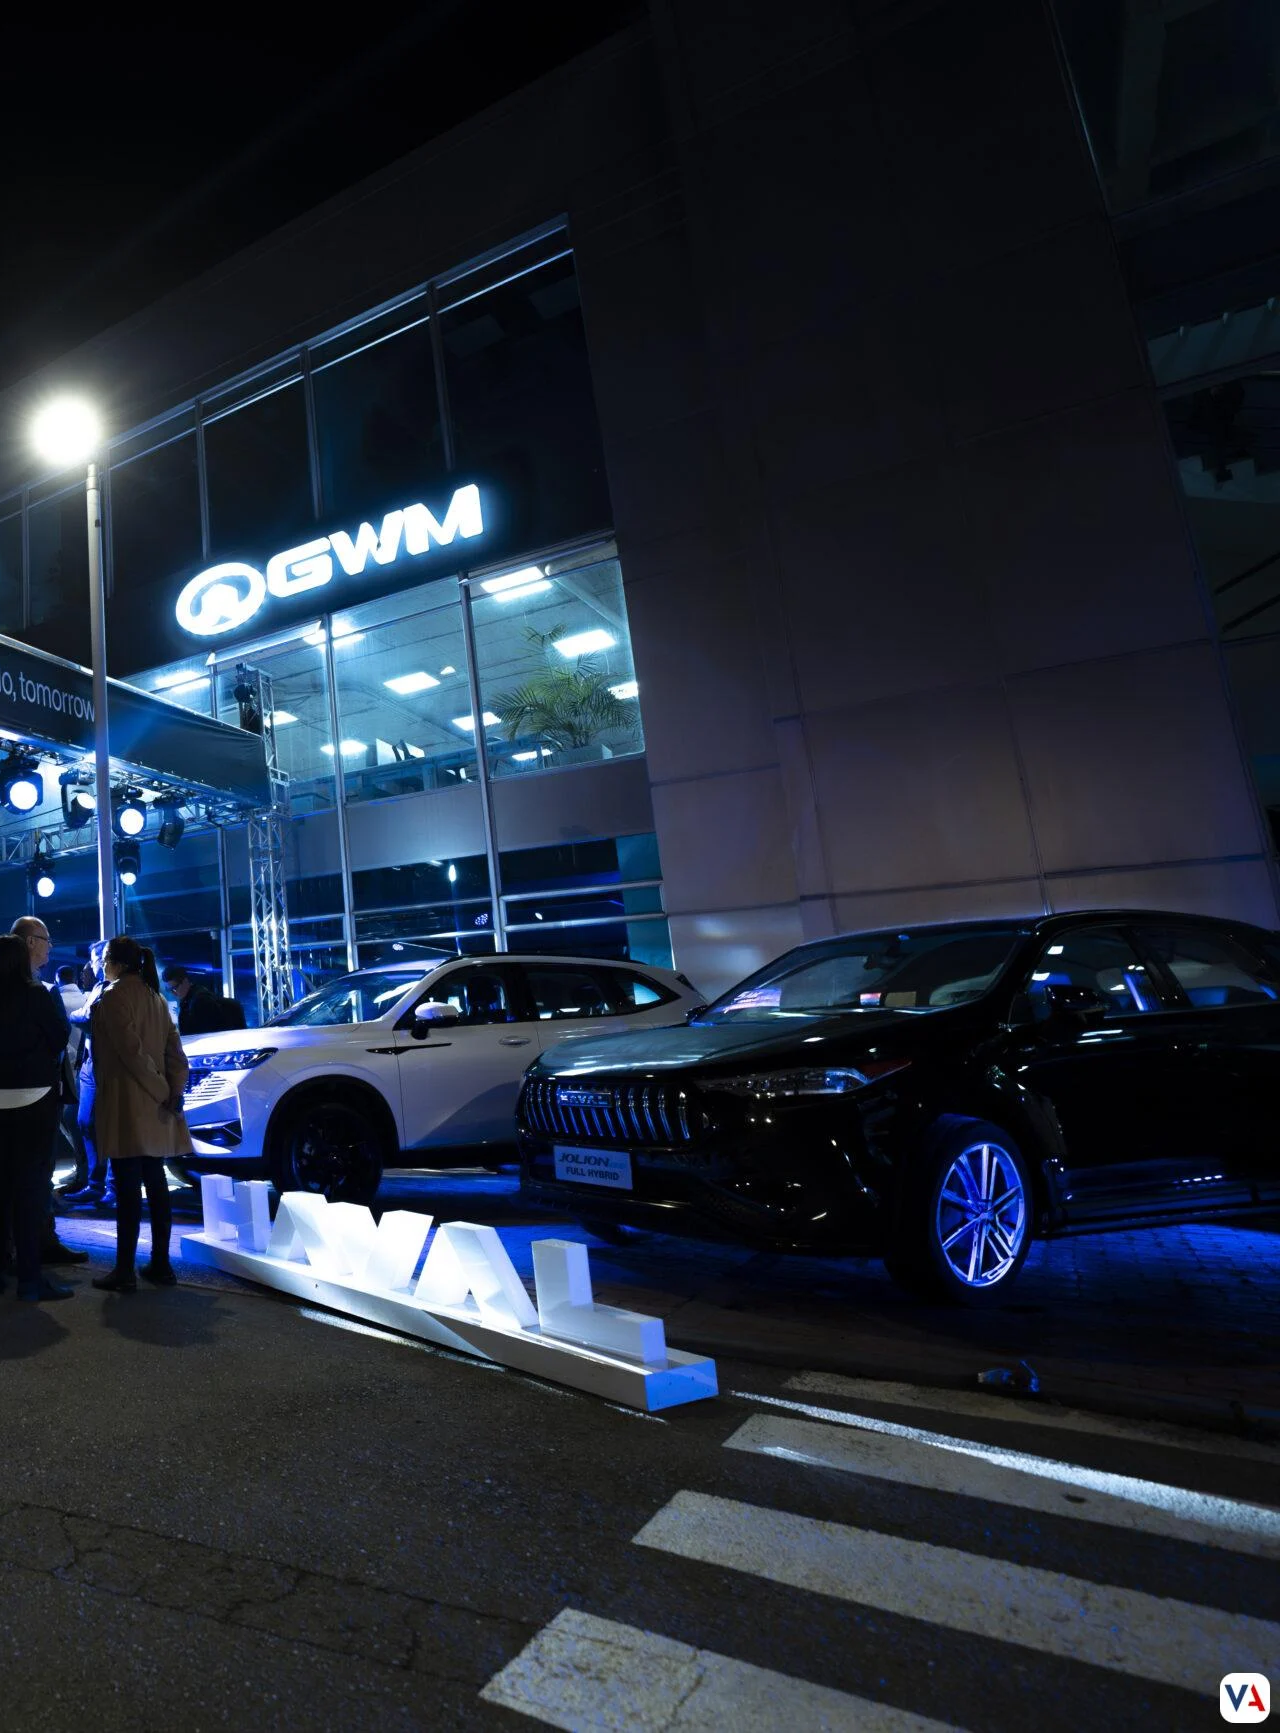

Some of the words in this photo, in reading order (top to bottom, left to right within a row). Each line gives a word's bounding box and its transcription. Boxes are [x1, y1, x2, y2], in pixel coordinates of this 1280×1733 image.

[267, 483, 483, 597] GWM
[19, 671, 95, 722] tomorrow
[559, 1152, 609, 1167] JOLION
[566, 1166, 586, 1177] FULL
[587, 1169, 620, 1181] HYBRID
[202, 1174, 668, 1369] HAVAL
